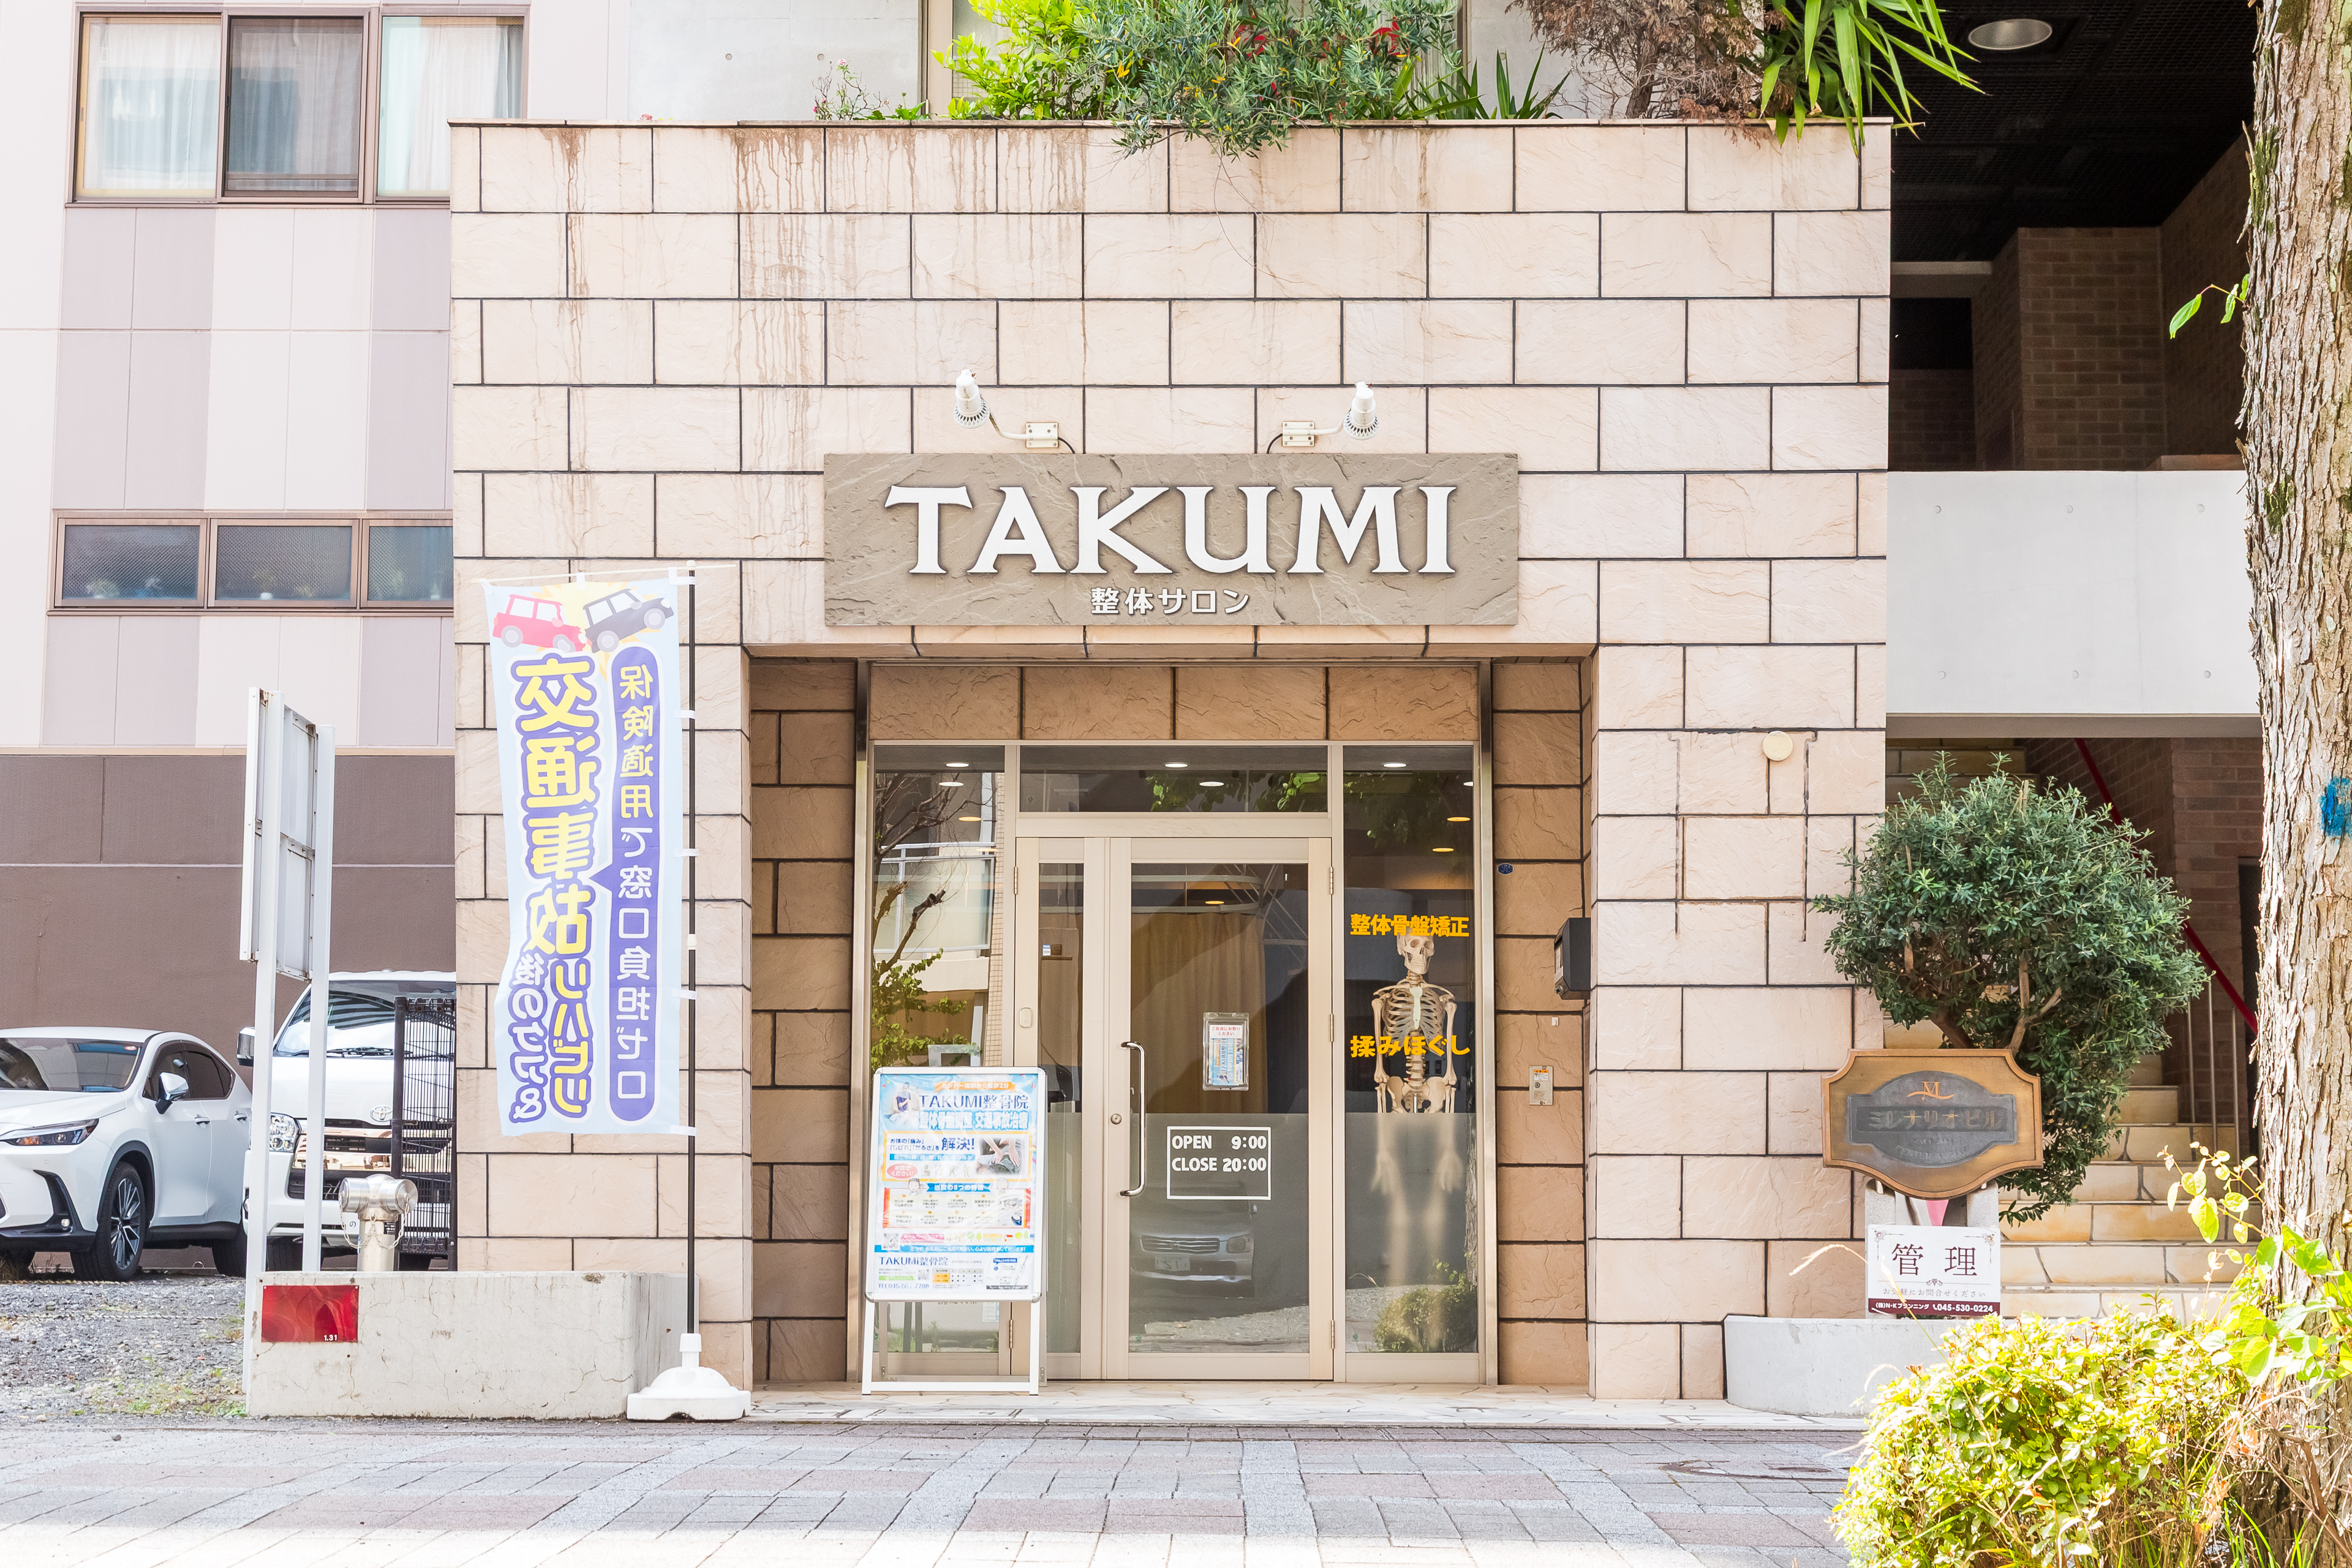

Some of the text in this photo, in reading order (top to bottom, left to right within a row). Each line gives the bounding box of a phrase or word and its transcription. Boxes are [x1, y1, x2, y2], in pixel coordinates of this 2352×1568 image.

[884, 486, 1457, 575] TAKUMI
[1091, 587, 1251, 616] 整体サロン
[1350, 913, 1469, 937] 整体骨盤矯正
[1350, 1035, 1471, 1058] 揉みほぐし
[1172, 1135, 1267, 1150] OPEN 9:00
[1172, 1157, 1267, 1172] CLOSE 20:00
[1891, 1243, 1977, 1276] 管理
[1937, 1303, 1994, 1313] 045-530-0224
